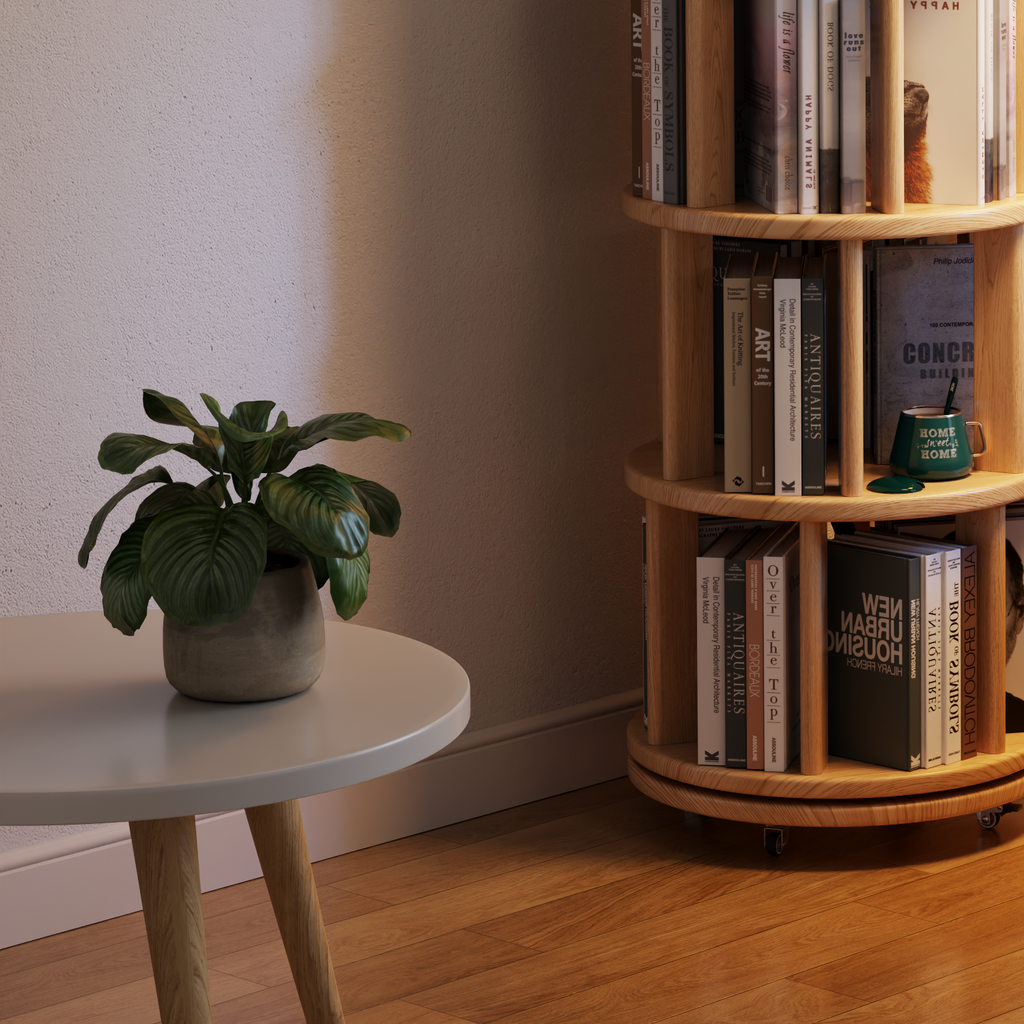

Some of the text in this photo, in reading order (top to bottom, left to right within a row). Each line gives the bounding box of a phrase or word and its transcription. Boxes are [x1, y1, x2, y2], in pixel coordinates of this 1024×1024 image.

[778, 11, 795, 26] life
[664, 27, 673, 72] BOOK
[778, 46, 795, 74] flower
[664, 91, 674, 172] SYMBOLS
[784, 156, 793, 170] chris
[778, 298, 786, 322] Virginia
[755, 328, 770, 362] ART
[788, 324, 796, 368] Contemporary
[903, 342, 974, 364] CONCR
[808, 333, 822, 439] ANTIQUAIRES
[920, 368, 974, 379] BUILDIN
[919, 427, 955, 438] HOME
[924, 437, 950, 447] sweet
[921, 448, 957, 459] HOME
[701, 577, 709, 598] Virginia
[768, 565, 778, 614] Over
[711, 602, 720, 644] Contemporary
[731, 612, 745, 714] ANTIQUAIRES
[769, 630, 777, 665] the
[748, 644, 760, 698] BORDEAUX
